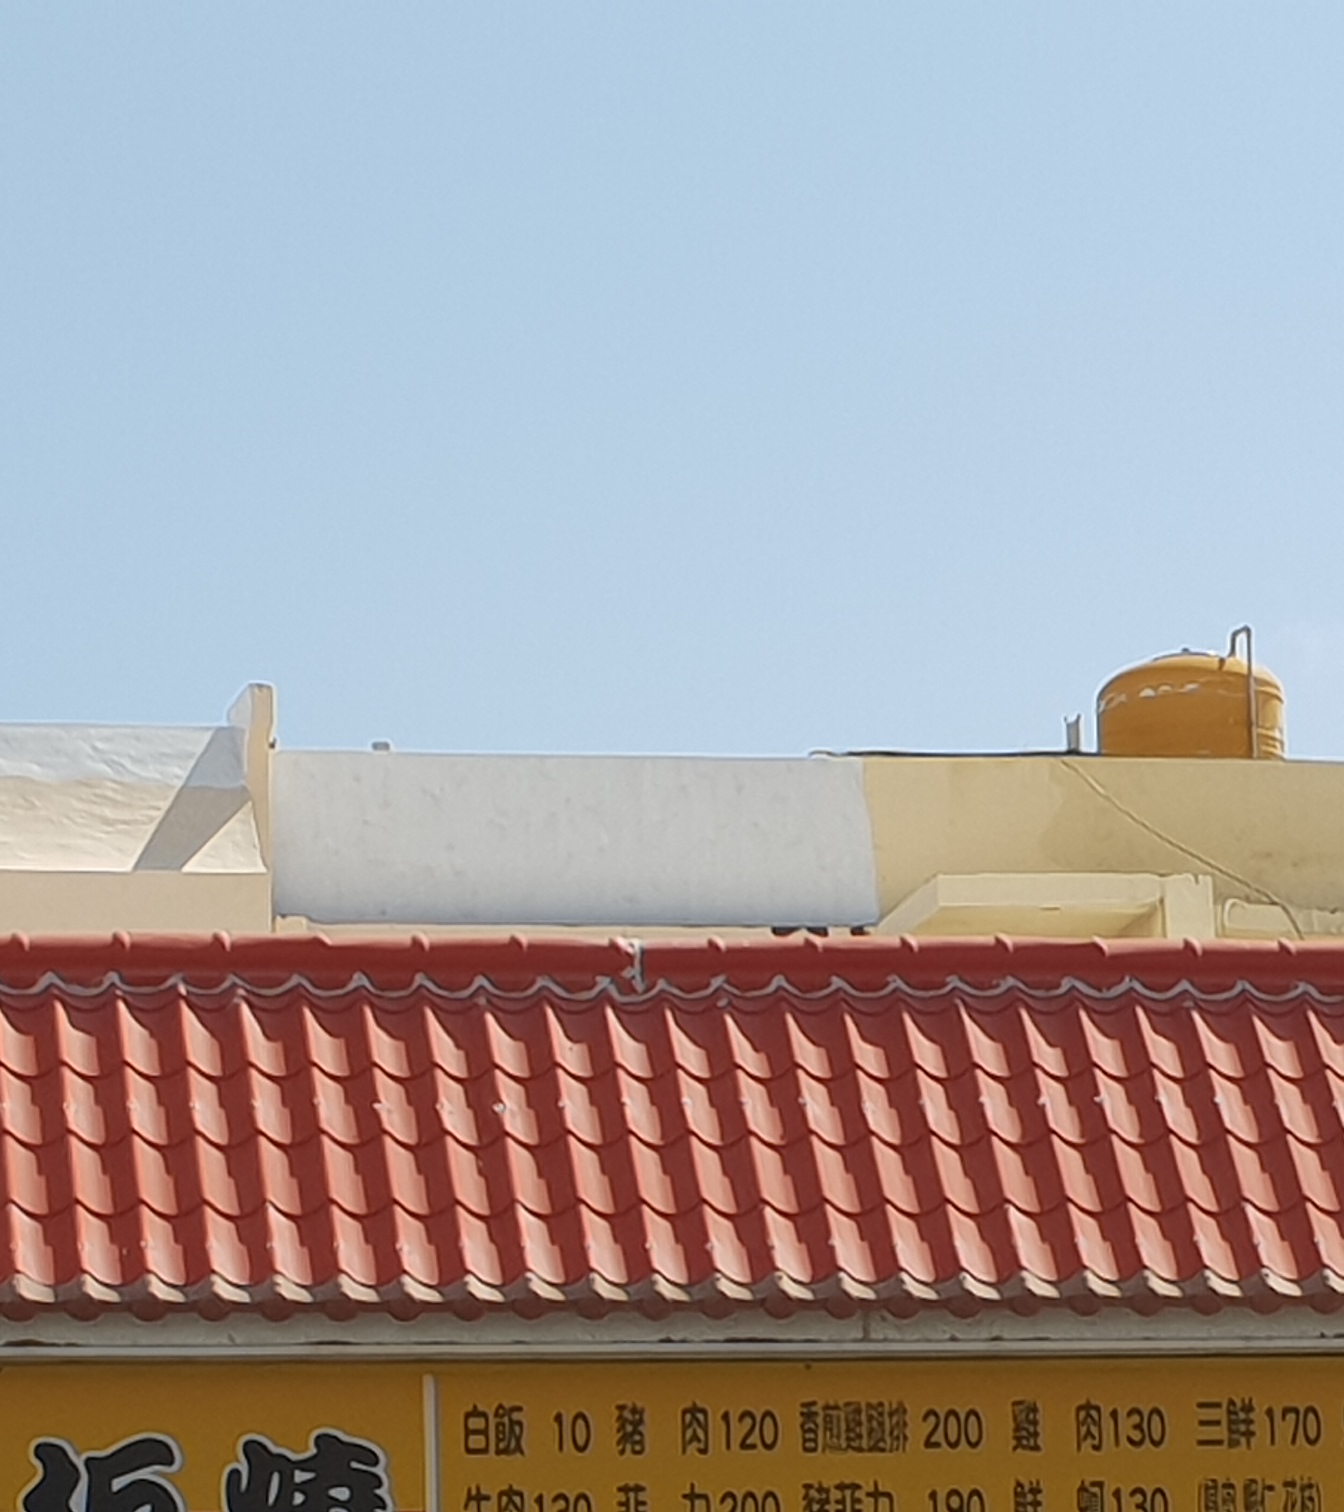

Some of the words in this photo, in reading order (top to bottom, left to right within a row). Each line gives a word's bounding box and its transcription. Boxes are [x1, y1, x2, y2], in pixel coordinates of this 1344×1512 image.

[463, 1403, 525, 1457] 白飯
[553, 1411, 592, 1454] 10
[720, 1409, 779, 1452] 120
[922, 1408, 984, 1450] 200
[1109, 1406, 1167, 1449] 130
[1196, 1397, 1256, 1450] 三鮮
[1264, 1405, 1322, 1447] 170
